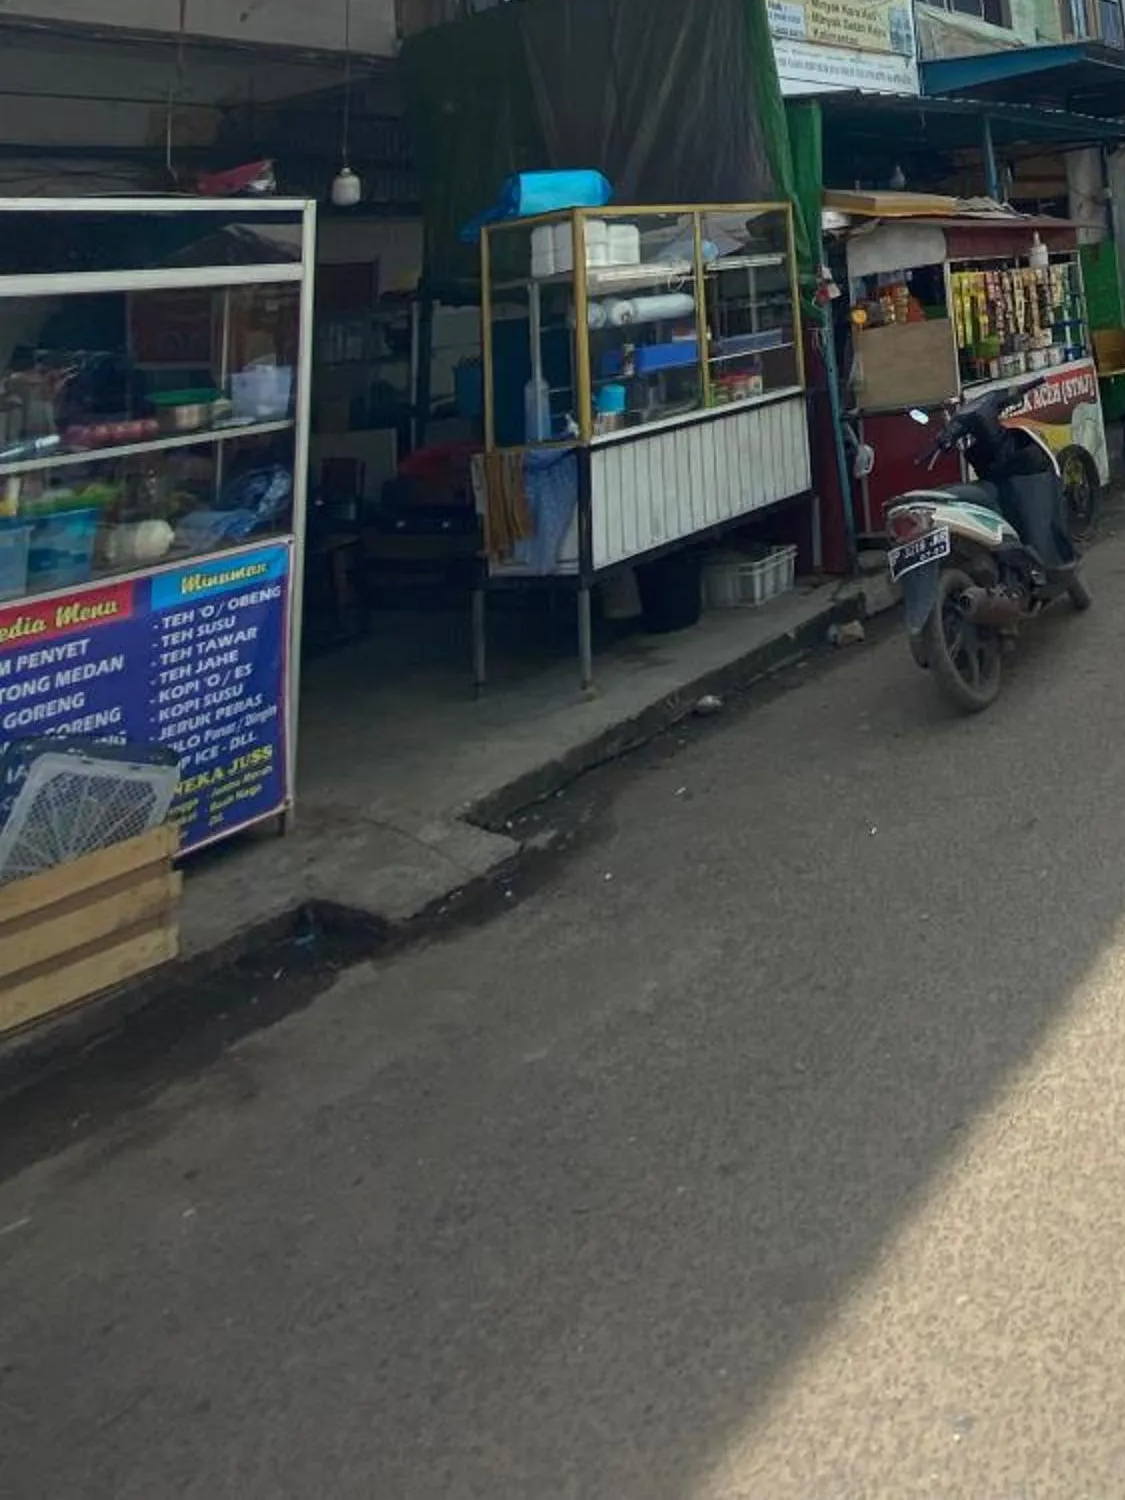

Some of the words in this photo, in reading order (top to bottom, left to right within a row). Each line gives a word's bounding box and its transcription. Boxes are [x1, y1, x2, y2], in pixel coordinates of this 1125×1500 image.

[56, 601, 118, 628] Menu
[162, 610, 195, 629] TEH
[160, 646, 193, 666] TEH
[196, 627, 258, 654] TAWAR
[162, 628, 194, 648] TEH
[197, 616, 237, 637] SUSU
[16, 638, 91, 673] PENYET
[55, 654, 125, 689] MEDAN
[160, 664, 192, 684] TEH
[196, 650, 239, 674] JAHE
[159, 680, 199, 703] KOPI
[159, 698, 199, 721] KOPI
[204, 684, 243, 707] SUSU
[3, 691, 85, 730] GORENG
[159, 712, 212, 740] JERUK
